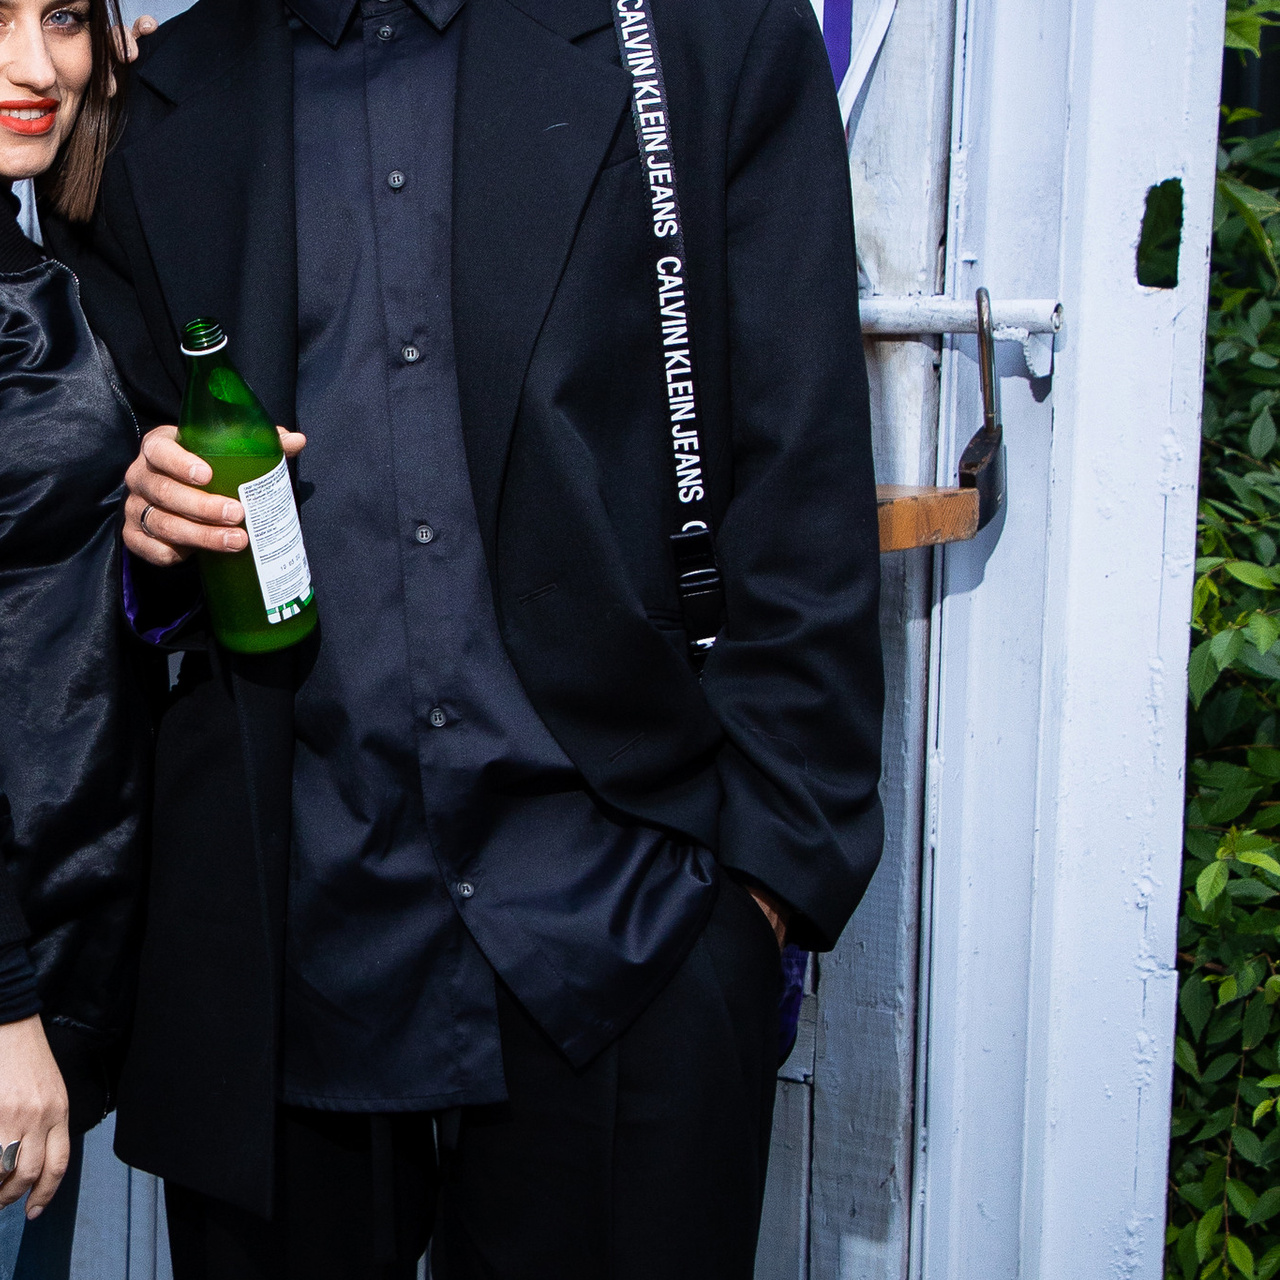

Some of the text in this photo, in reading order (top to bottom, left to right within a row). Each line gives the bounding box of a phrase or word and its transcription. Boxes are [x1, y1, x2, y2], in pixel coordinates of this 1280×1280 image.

[632, 79, 668, 152] KLEIN
[647, 155, 678, 238] JEANS
[656, 256, 688, 346] CALVIN
[664, 349, 696, 421] KLEIN
[671, 423, 704, 504] JEANS
